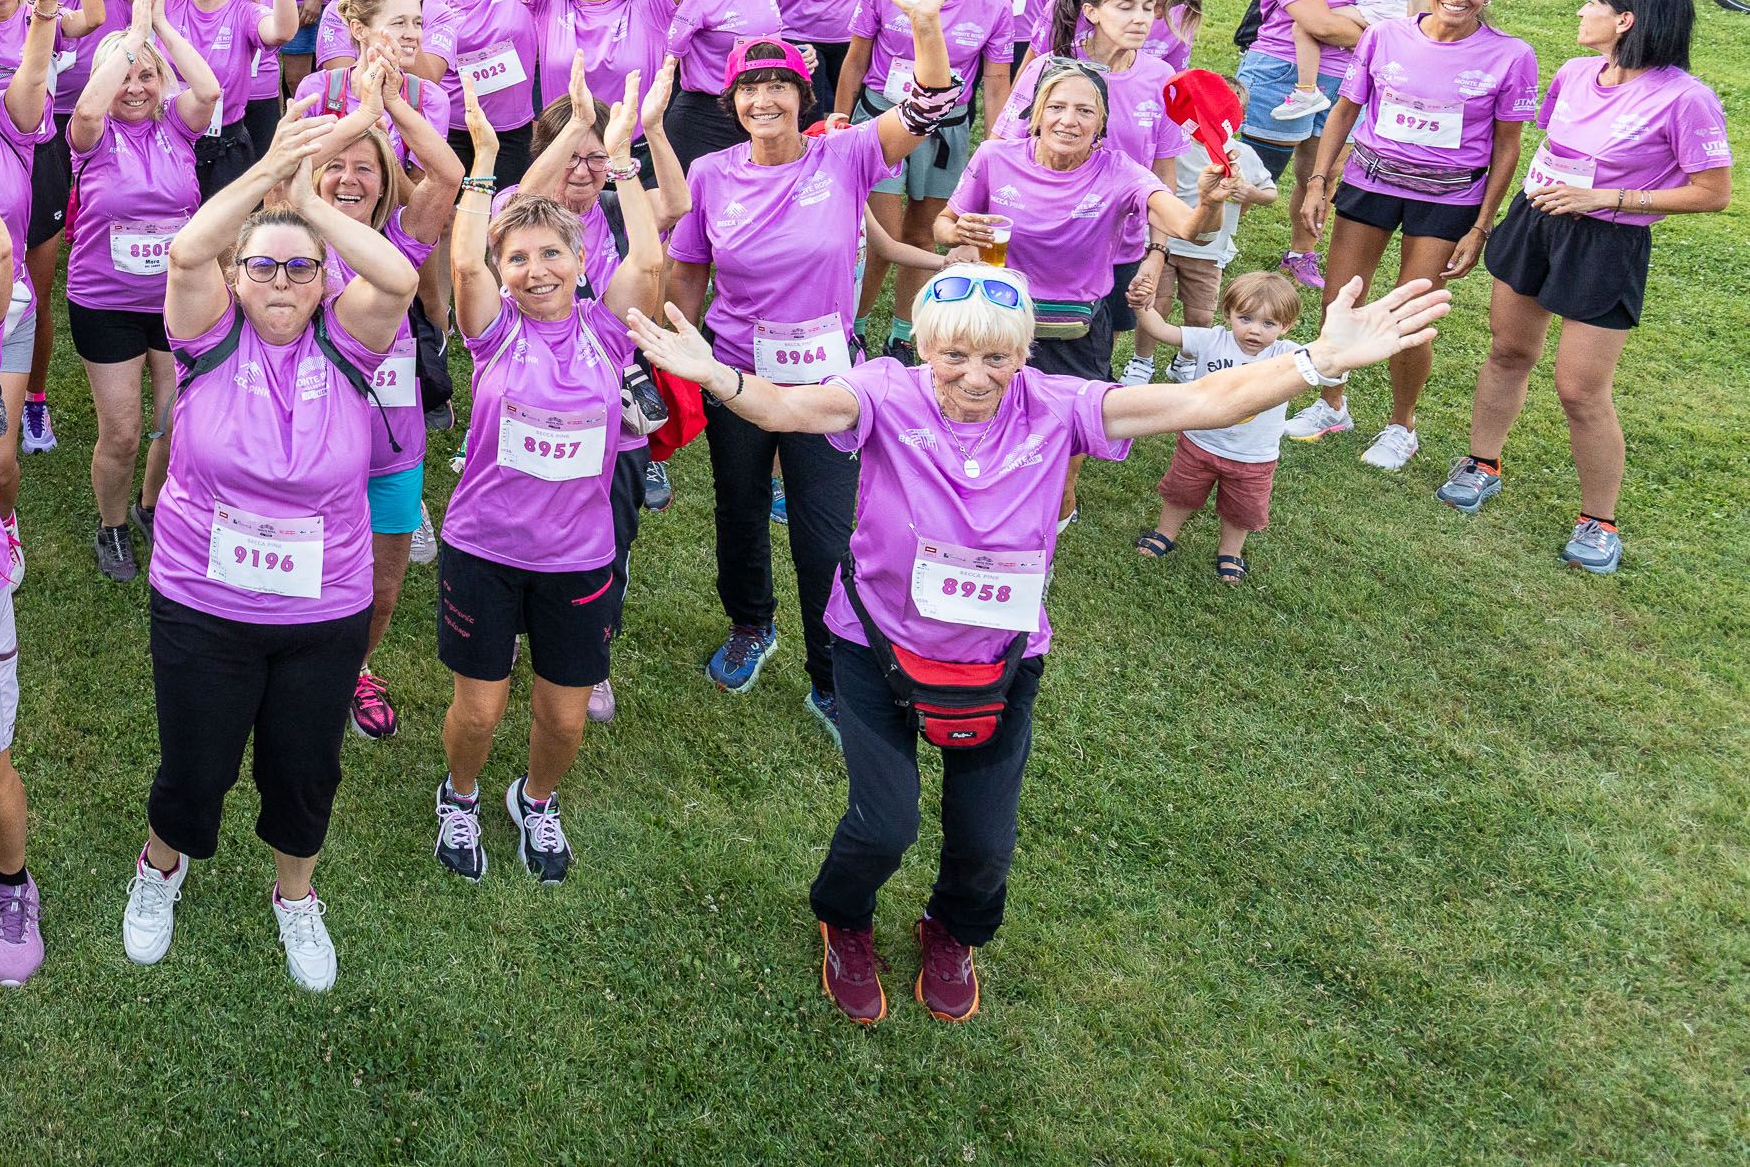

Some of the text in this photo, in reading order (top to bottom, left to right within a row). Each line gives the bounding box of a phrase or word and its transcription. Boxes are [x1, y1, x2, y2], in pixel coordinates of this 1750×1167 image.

[472, 62, 507, 82] 9023
[1395, 113, 1440, 132] 8975
[775, 345, 827, 365] 8964
[296, 375, 318, 388] ONTE
[376, 369, 397, 387] 52
[523, 435, 582, 460] 8957
[234, 545, 294, 573] 9196
[941, 577, 1012, 603] 8958
